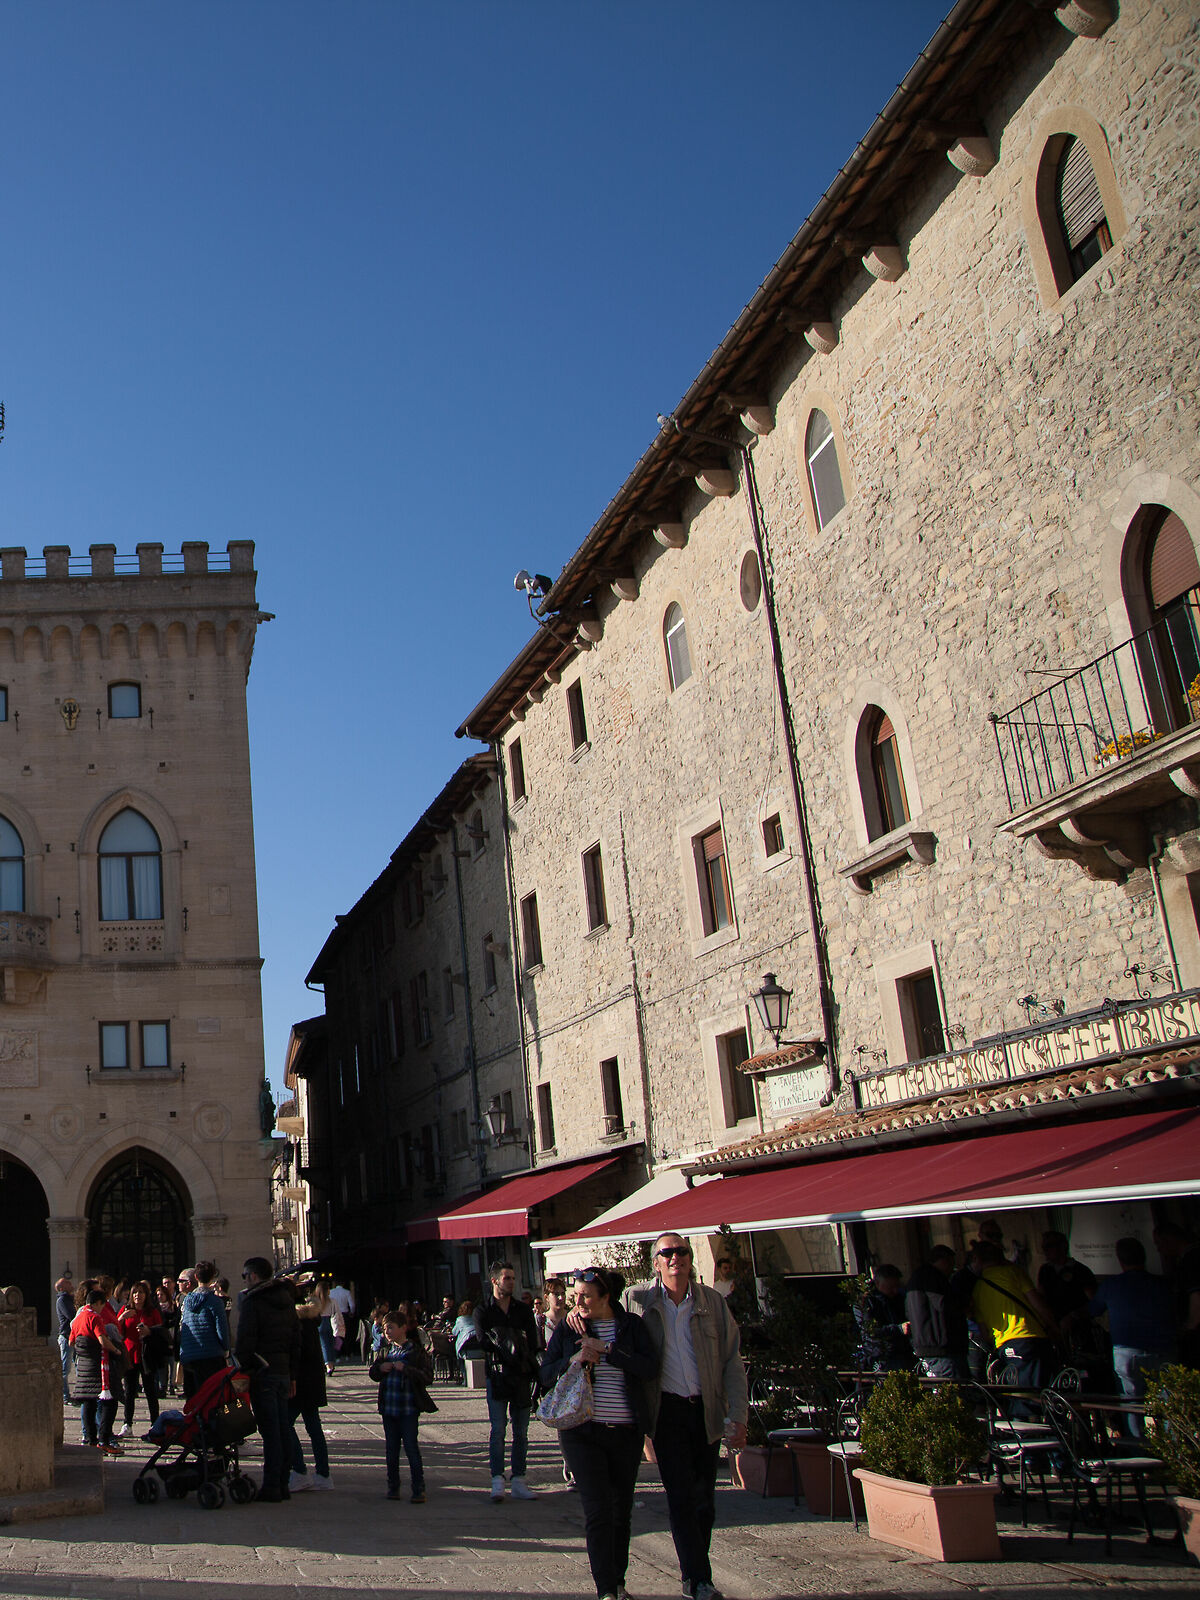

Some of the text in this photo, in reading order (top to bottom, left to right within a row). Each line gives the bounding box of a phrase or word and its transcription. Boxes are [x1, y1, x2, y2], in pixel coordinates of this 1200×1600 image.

[778, 1070, 814, 1086] TAVERNA
[893, 1044, 1006, 1100] TAVERNA
[778, 1089, 819, 1108] PIANELLO
